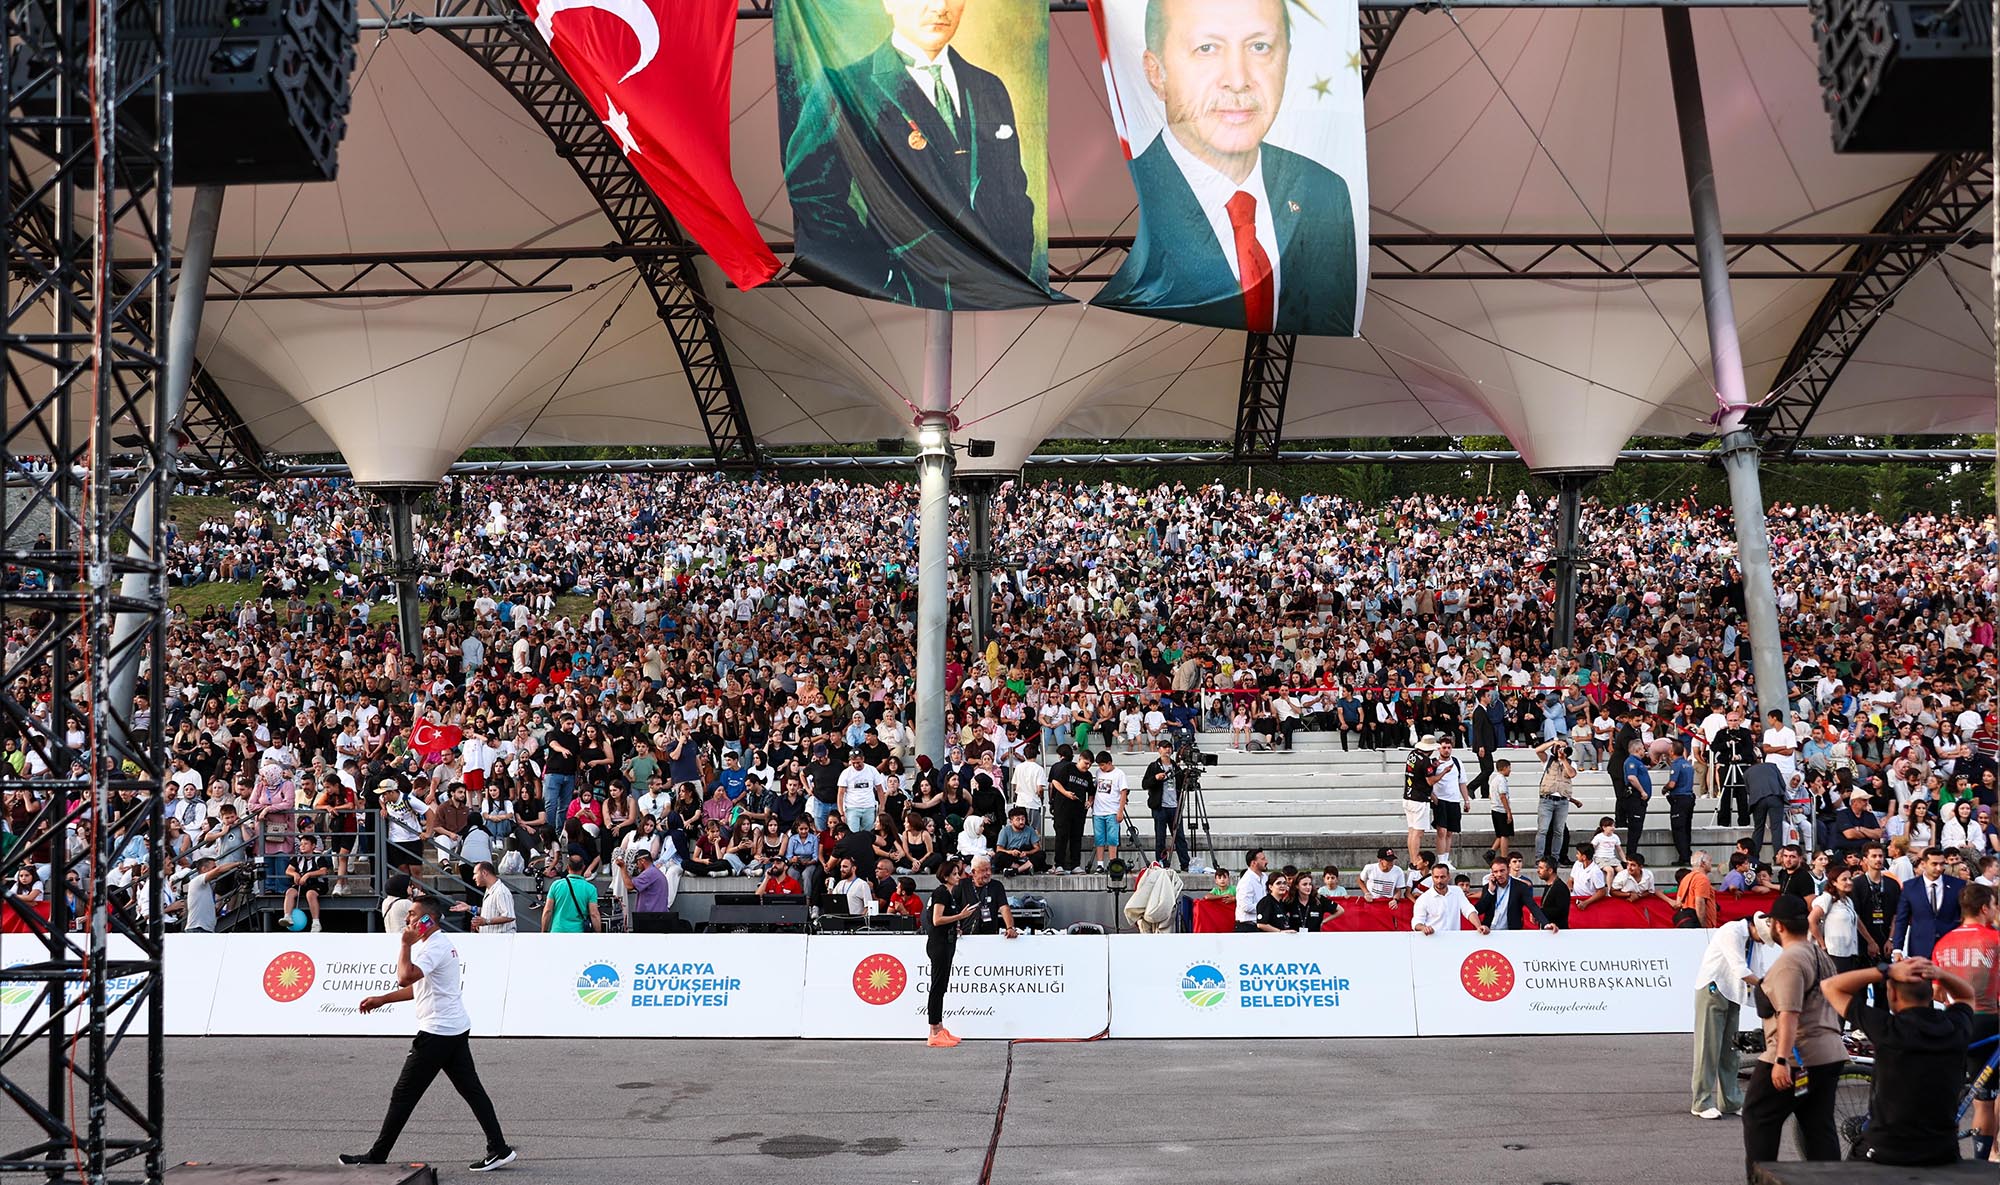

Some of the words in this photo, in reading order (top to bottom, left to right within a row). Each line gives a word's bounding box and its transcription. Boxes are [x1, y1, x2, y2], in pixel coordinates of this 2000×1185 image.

[1523, 958, 1577, 973] TÜRKİYE
[1580, 957, 1669, 971] CUMHURİYETİ
[1936, 947, 1994, 968] HUN
[326, 961, 376, 974] TÜRKİYE
[634, 963, 715, 975] SAKARYA
[917, 963, 971, 976] TÜİYE
[974, 963, 1064, 977] CUMHURİYETİ
[1239, 963, 1322, 976] SAKARYA
[633, 976, 741, 993] BÜYÜKŞEHİR
[916, 981, 1065, 996] CHURBAŞKANLIĞI
[1240, 976, 1351, 993] BÜYÜKŞEHİR
[1525, 974, 1673, 991] CUMHURBAŞKANLIĞI
[631, 991, 728, 1007] BELEDİYESİ
[1241, 992, 1340, 1008] BELEDİYESİ
[1528, 1001, 1608, 1015] Himayelerinde
